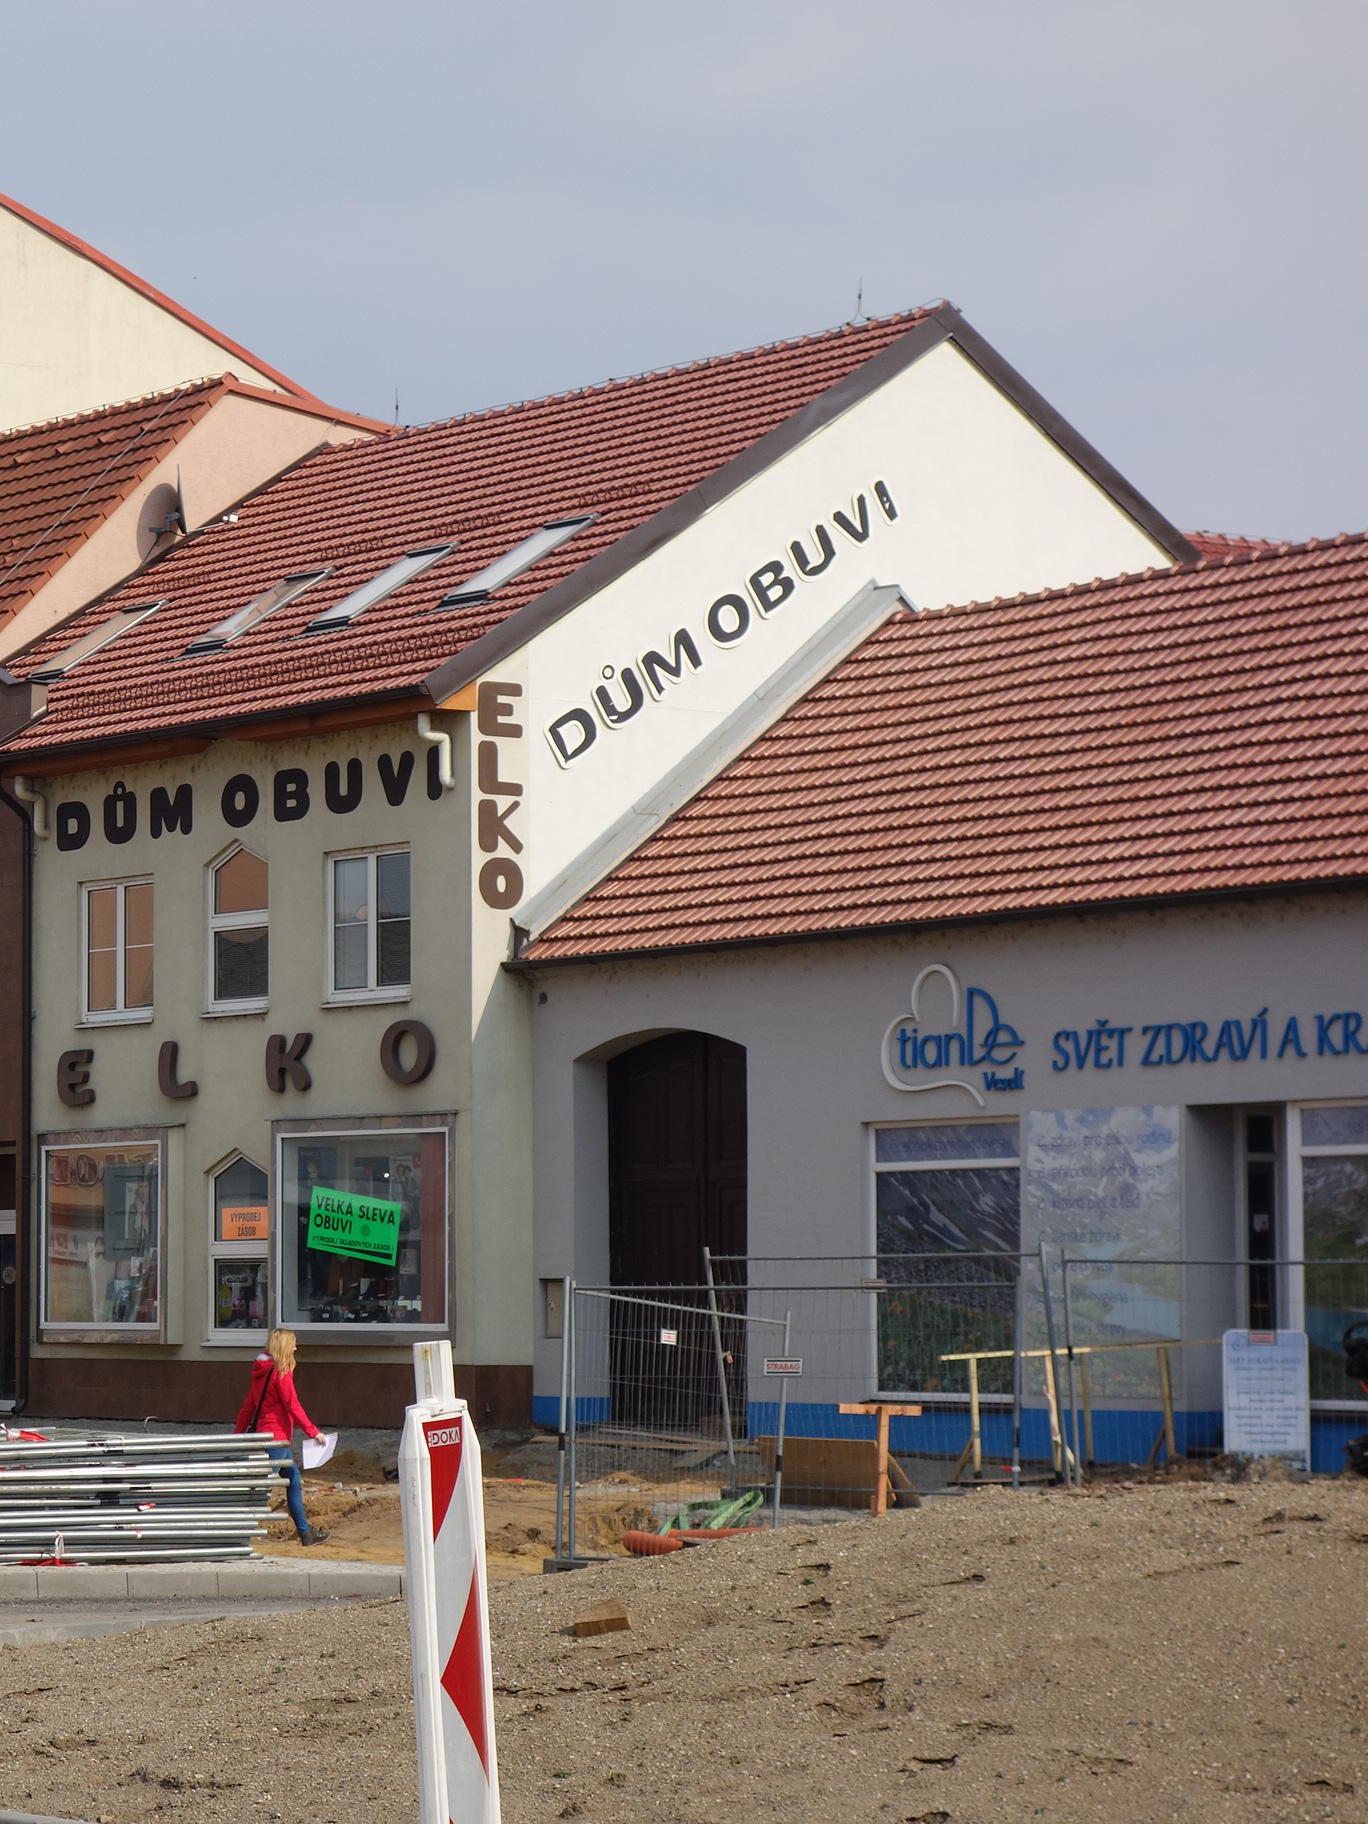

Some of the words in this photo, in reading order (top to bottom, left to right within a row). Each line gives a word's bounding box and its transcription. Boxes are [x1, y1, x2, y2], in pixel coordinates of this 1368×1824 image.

[546, 627, 704, 769] DŮM
[706, 479, 900, 649] OBUVI
[56, 781, 193, 852] DŮM
[221, 745, 443, 828] OBUVI
[477, 681, 524, 909] ELKO
[896, 986, 1026, 1069] tianDe
[1052, 1019, 1133, 1072] SVĚT
[1140, 1007, 1269, 1066] ZDRAVÍ
[1277, 1016, 1308, 1059] A
[57, 1019, 436, 1106] ELKO
[230, 1210, 261, 1222] VÝPRODEJ
[237, 1224, 257, 1236] ZÁSOB
[313, 1213, 352, 1235] OBUVI
[316, 1195, 353, 1217] VELKÁ
[358, 1204, 396, 1226] SLEVA
[766, 1363, 800, 1371] STRABAG
[432, 1431, 459, 1445] DOKA
